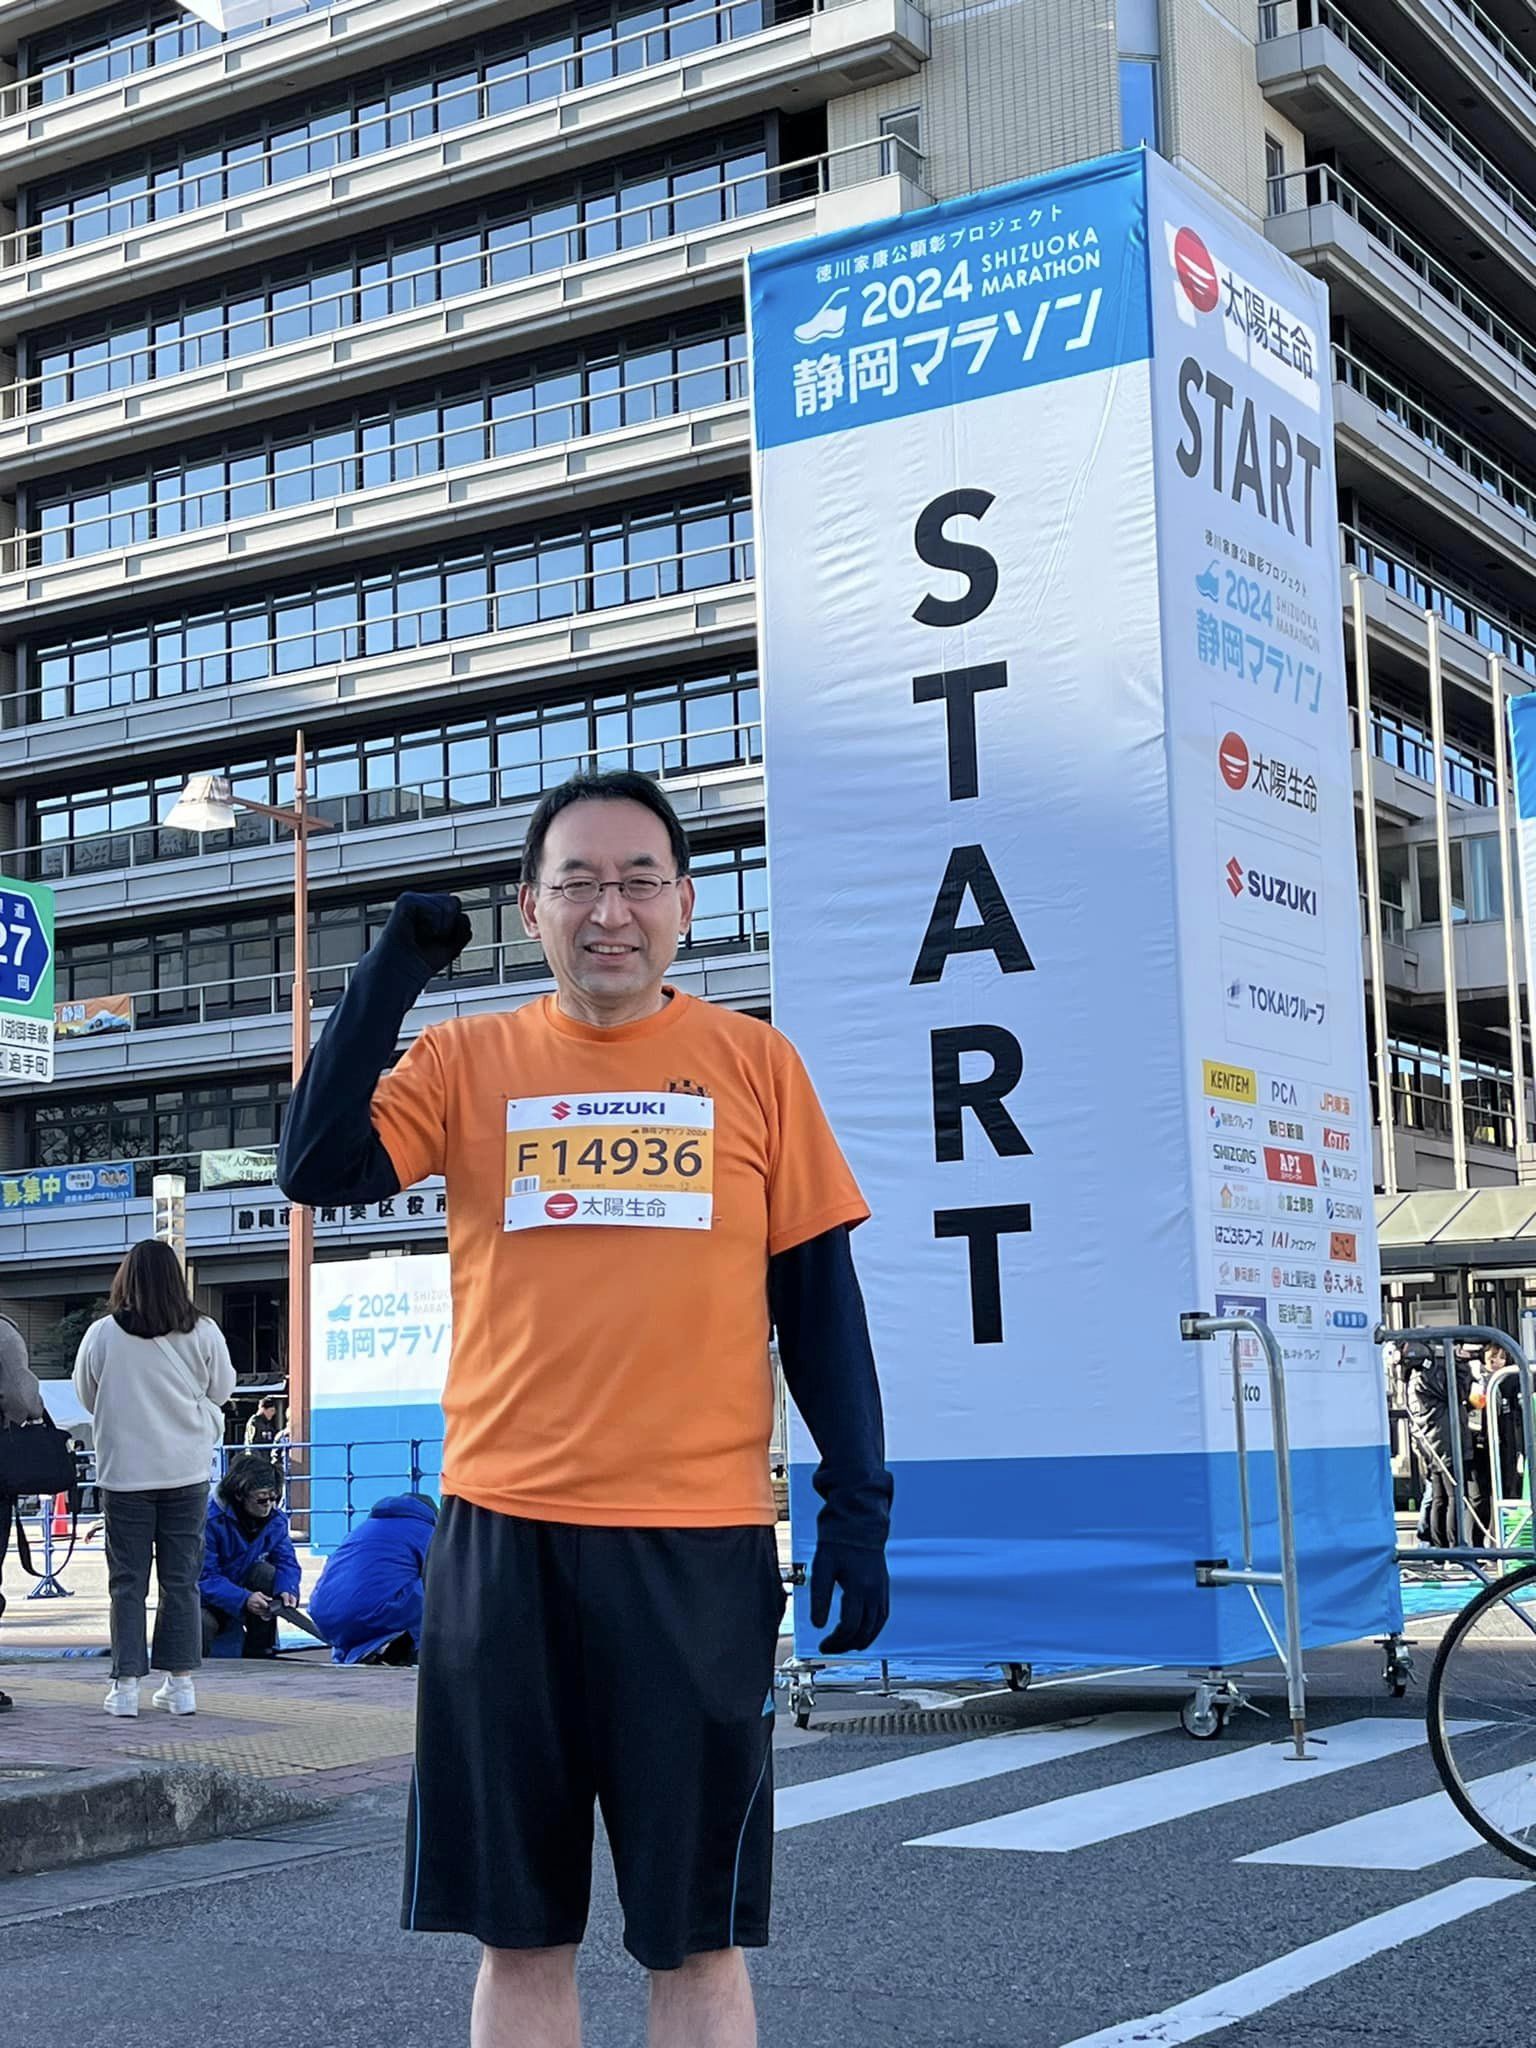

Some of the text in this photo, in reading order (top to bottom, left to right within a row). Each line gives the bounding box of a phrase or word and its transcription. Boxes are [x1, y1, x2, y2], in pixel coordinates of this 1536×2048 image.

[981, 227, 1099, 273] SHIZUOKA
[861, 259, 972, 327] 2024
[981, 250, 1100, 297] MARATHON
[1221, 272, 1313, 379] 太陽生命
[792, 288, 1102, 418] 静岡マラソン
[1176, 357, 1321, 548] START
[1225, 569, 1274, 626] 2024
[1196, 608, 1322, 714] 静岡マラソン
[1252, 753, 1318, 814] 太陽生命
[912, 488, 1035, 1344] START
[1248, 870, 1317, 916] SUZUKI
[1248, 985, 1325, 1025] TOKAIグループ
[1210, 1070, 1250, 1094] KENTEM
[1272, 1081, 1298, 1106] PCA
[577, 1102, 665, 1116] SUZUKI
[1280, 1153, 1302, 1173] API
[582, 1197, 667, 1218] 太陽生命
[1214, 1225, 1264, 1247] はごろもフーズ
[359, 1293, 410, 1318] 2024
[326, 1323, 450, 1361] 静岡マラソ
